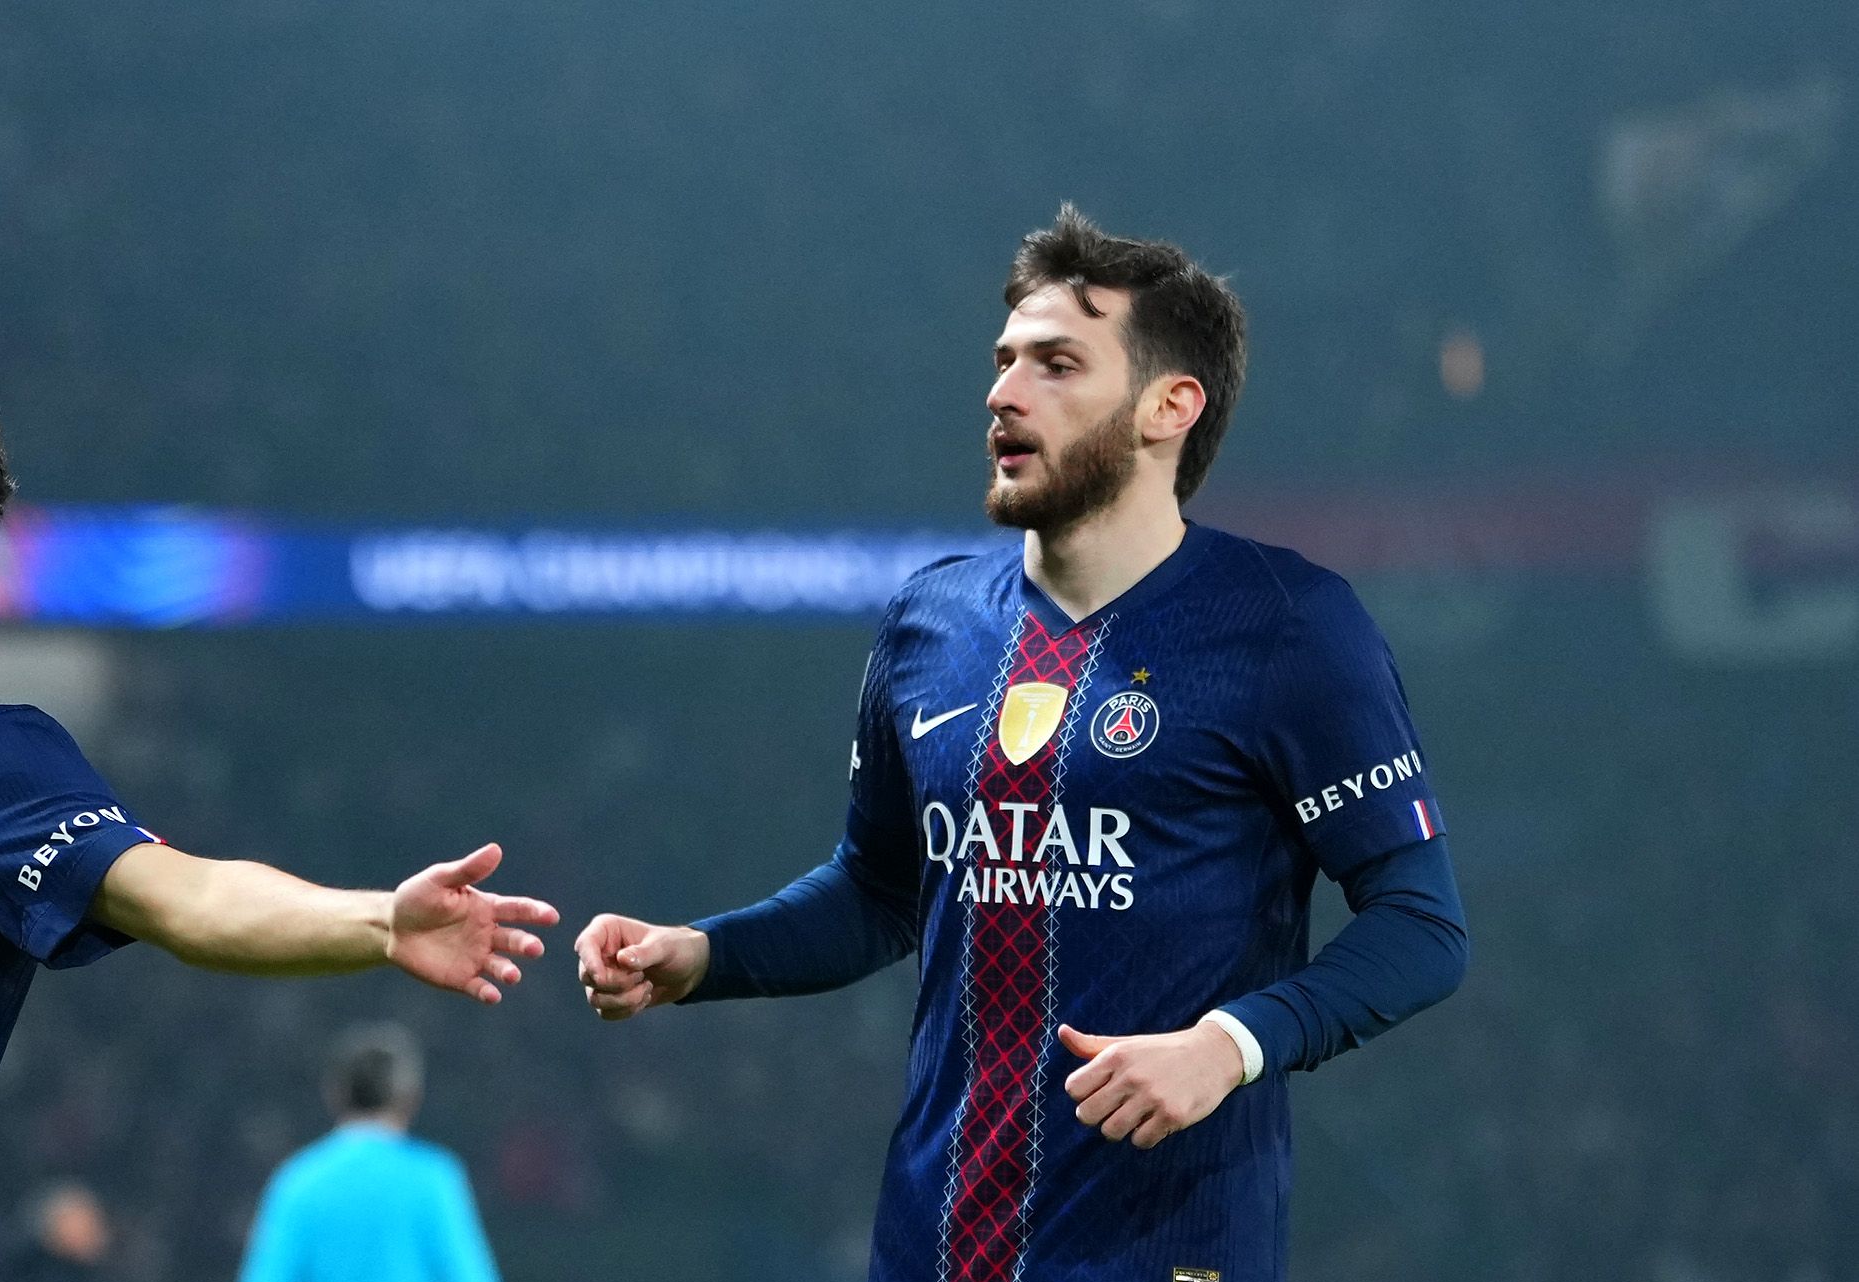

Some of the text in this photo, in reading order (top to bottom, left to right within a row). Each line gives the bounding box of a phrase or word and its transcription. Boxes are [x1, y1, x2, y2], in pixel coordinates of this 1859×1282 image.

[1108, 695, 1152, 713] PARIS
[18, 806, 127, 892] BEYON
[923, 800, 1135, 874] QATAR
[957, 866, 1134, 910] AIRWAYS
